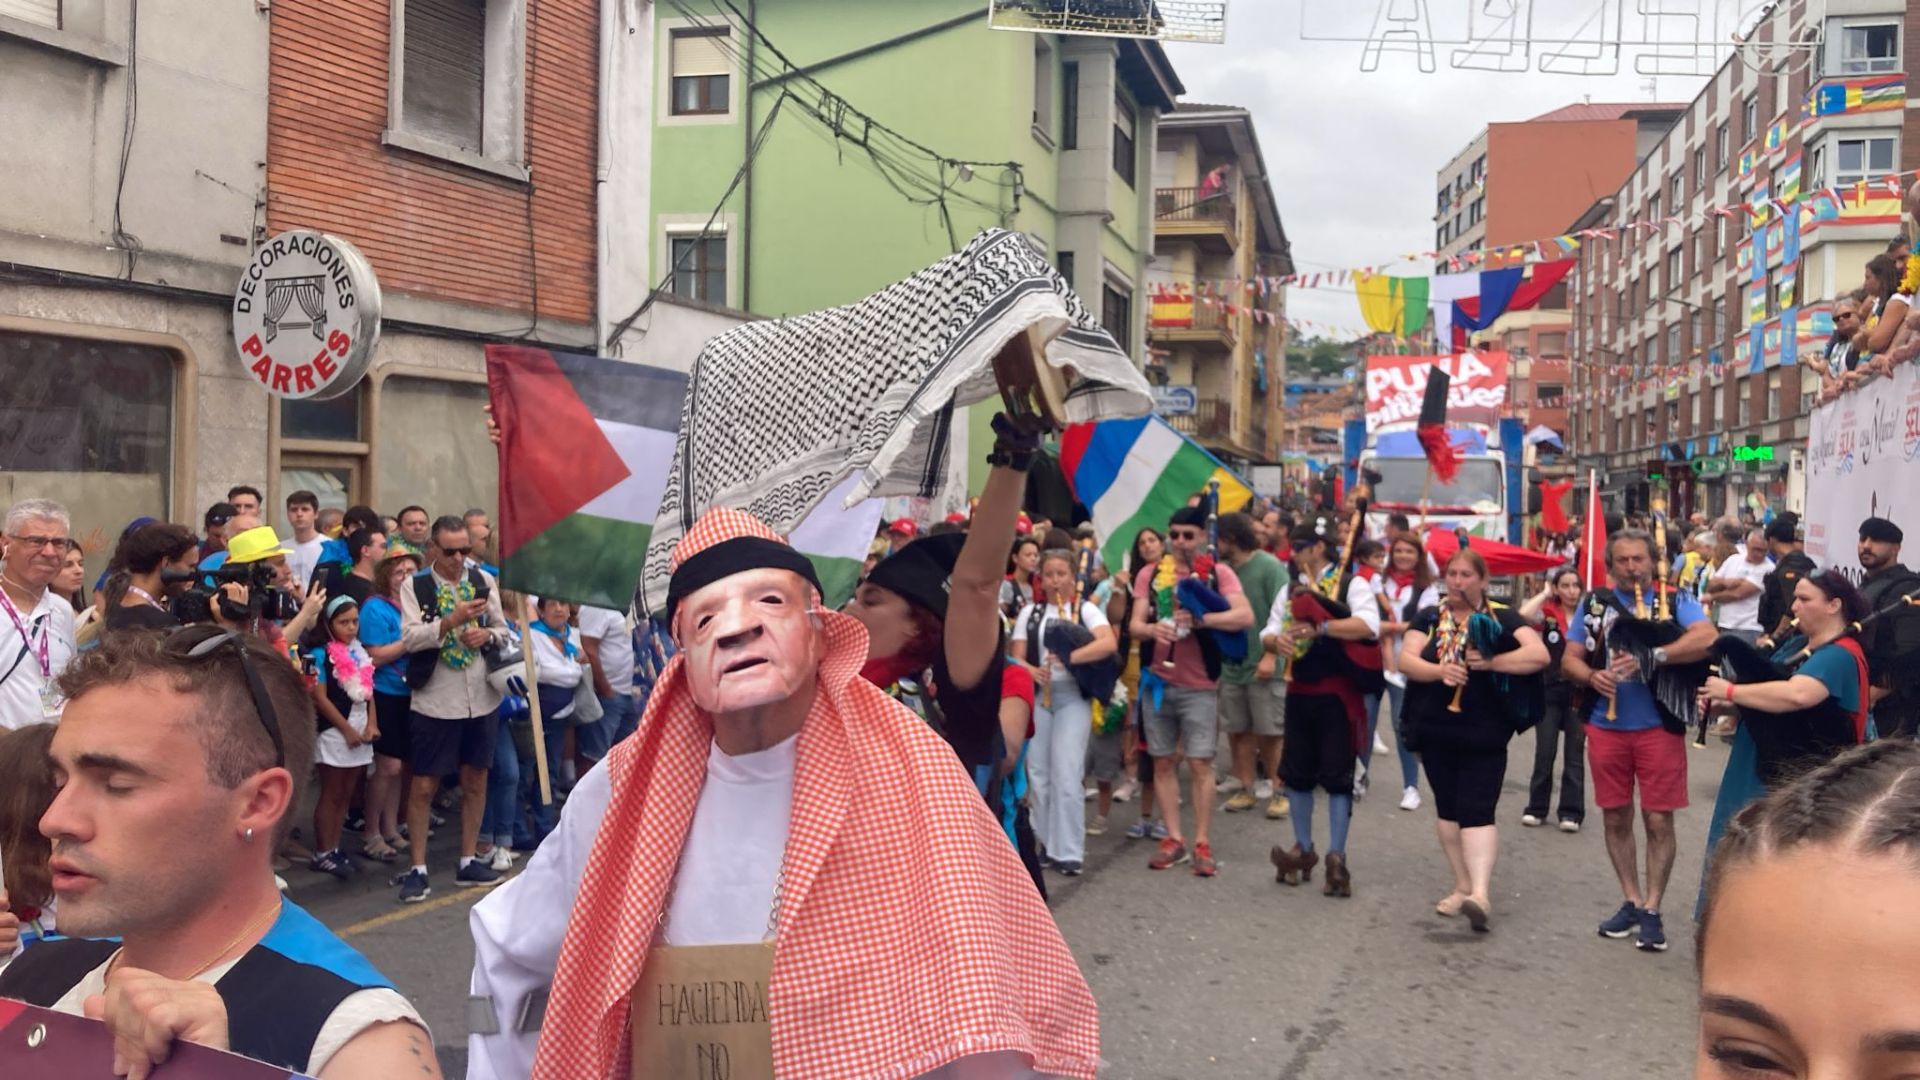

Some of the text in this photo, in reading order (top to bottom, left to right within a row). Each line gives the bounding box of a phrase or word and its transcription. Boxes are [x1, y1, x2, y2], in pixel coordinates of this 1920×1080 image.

[237, 235, 354, 314] DECORACIONES
[241, 329, 351, 394] PARRES
[657, 980, 768, 1026] HACIENDA
[697, 1042, 731, 1080] NO
